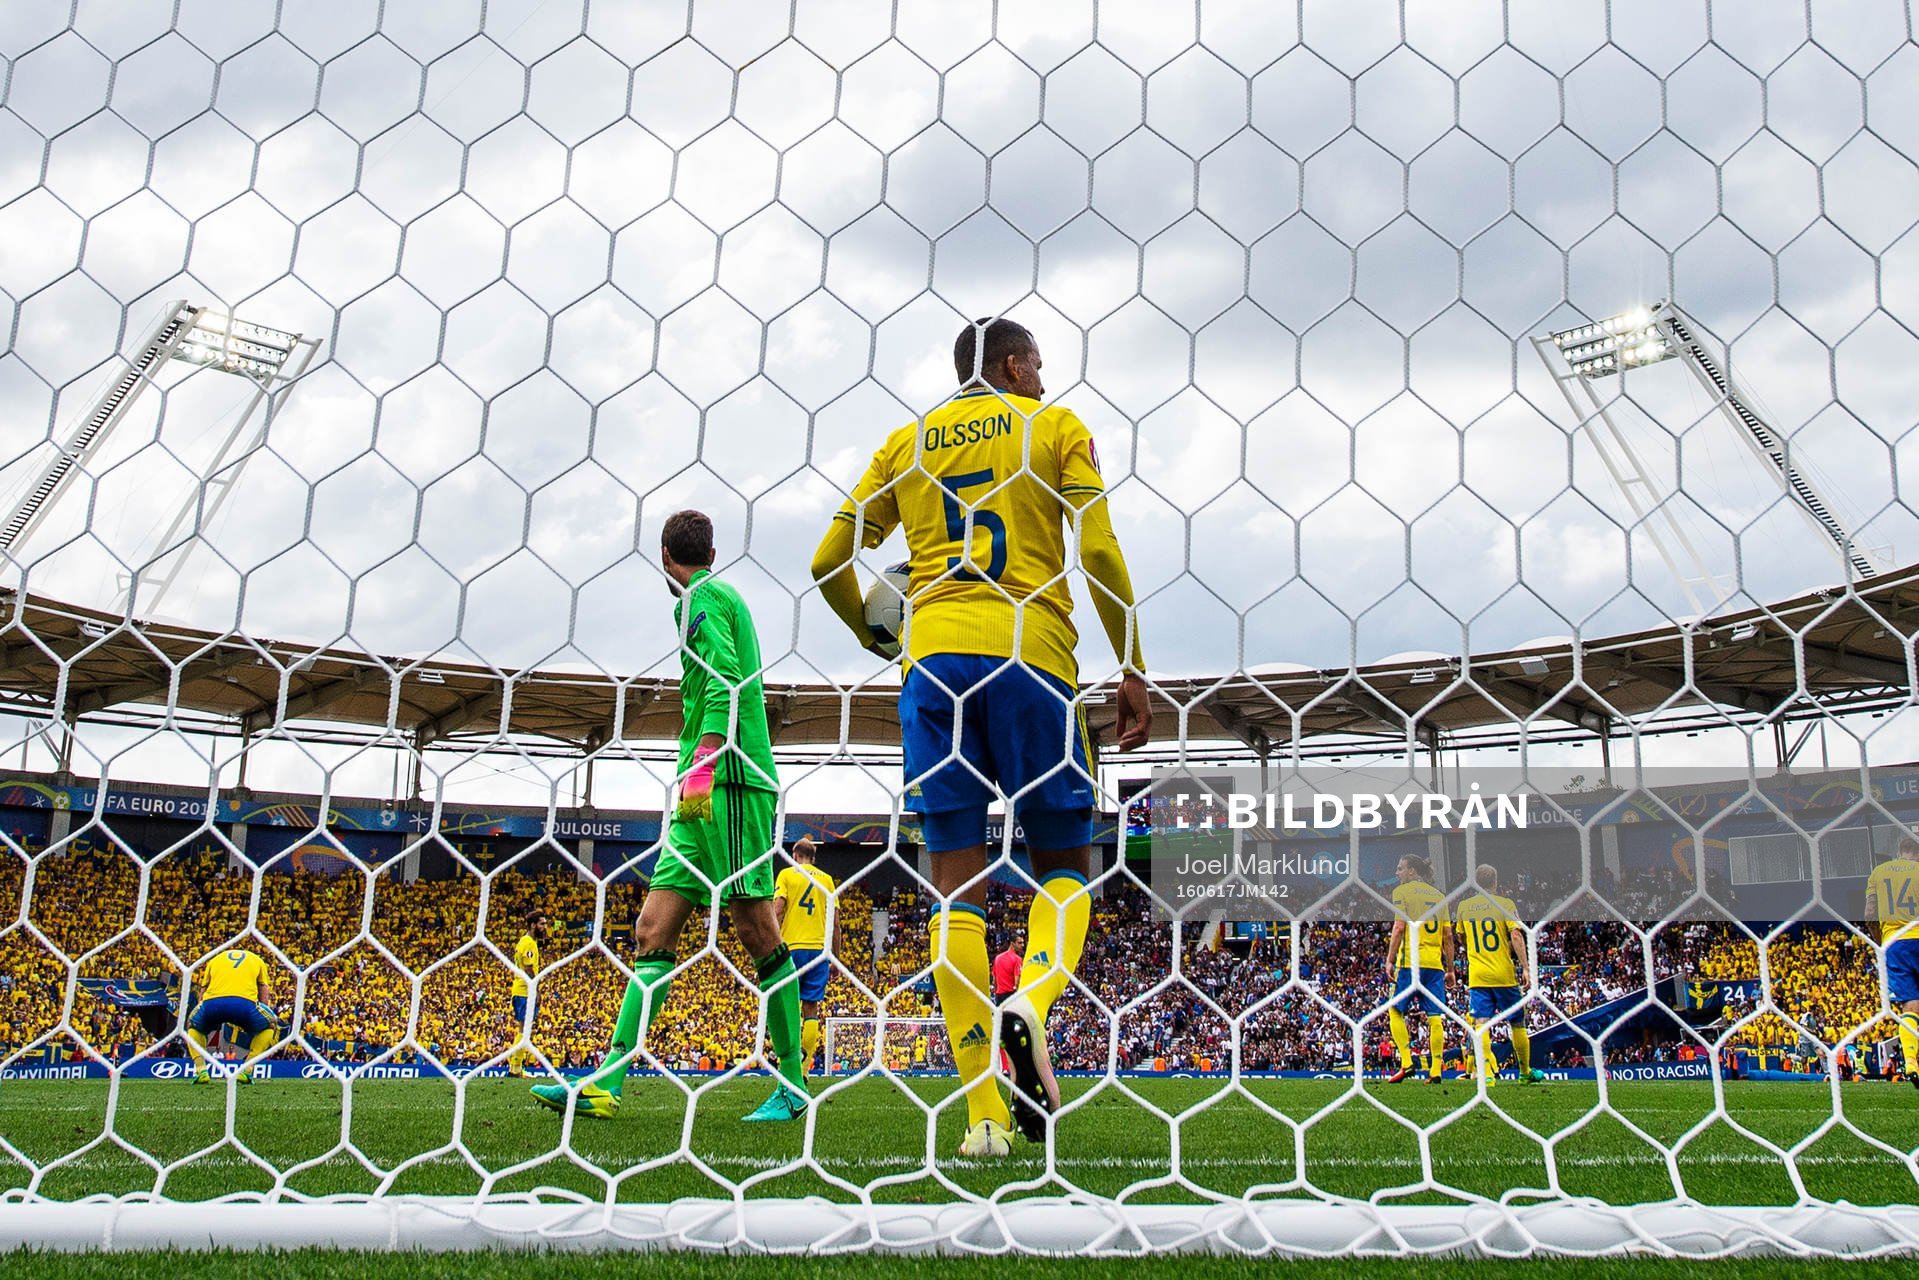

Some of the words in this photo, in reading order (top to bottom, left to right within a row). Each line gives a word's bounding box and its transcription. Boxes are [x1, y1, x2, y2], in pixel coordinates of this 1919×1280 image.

[925, 412, 1011, 451] OLSSON
[941, 467, 1007, 582] 5
[84, 793, 127, 810] UFA
[131, 797, 175, 814] EURO
[986, 826, 1025, 839] EUO
[798, 881, 815, 916] 4
[1884, 878, 1917, 916] 14
[1469, 916, 1500, 953] 18
[227, 951, 246, 969] 9
[1723, 986, 1746, 1002] 24
[1612, 1068, 1634, 1080] NO
[1635, 1067, 1654, 1080] TO
[1657, 1065, 1709, 1078] RACISM
